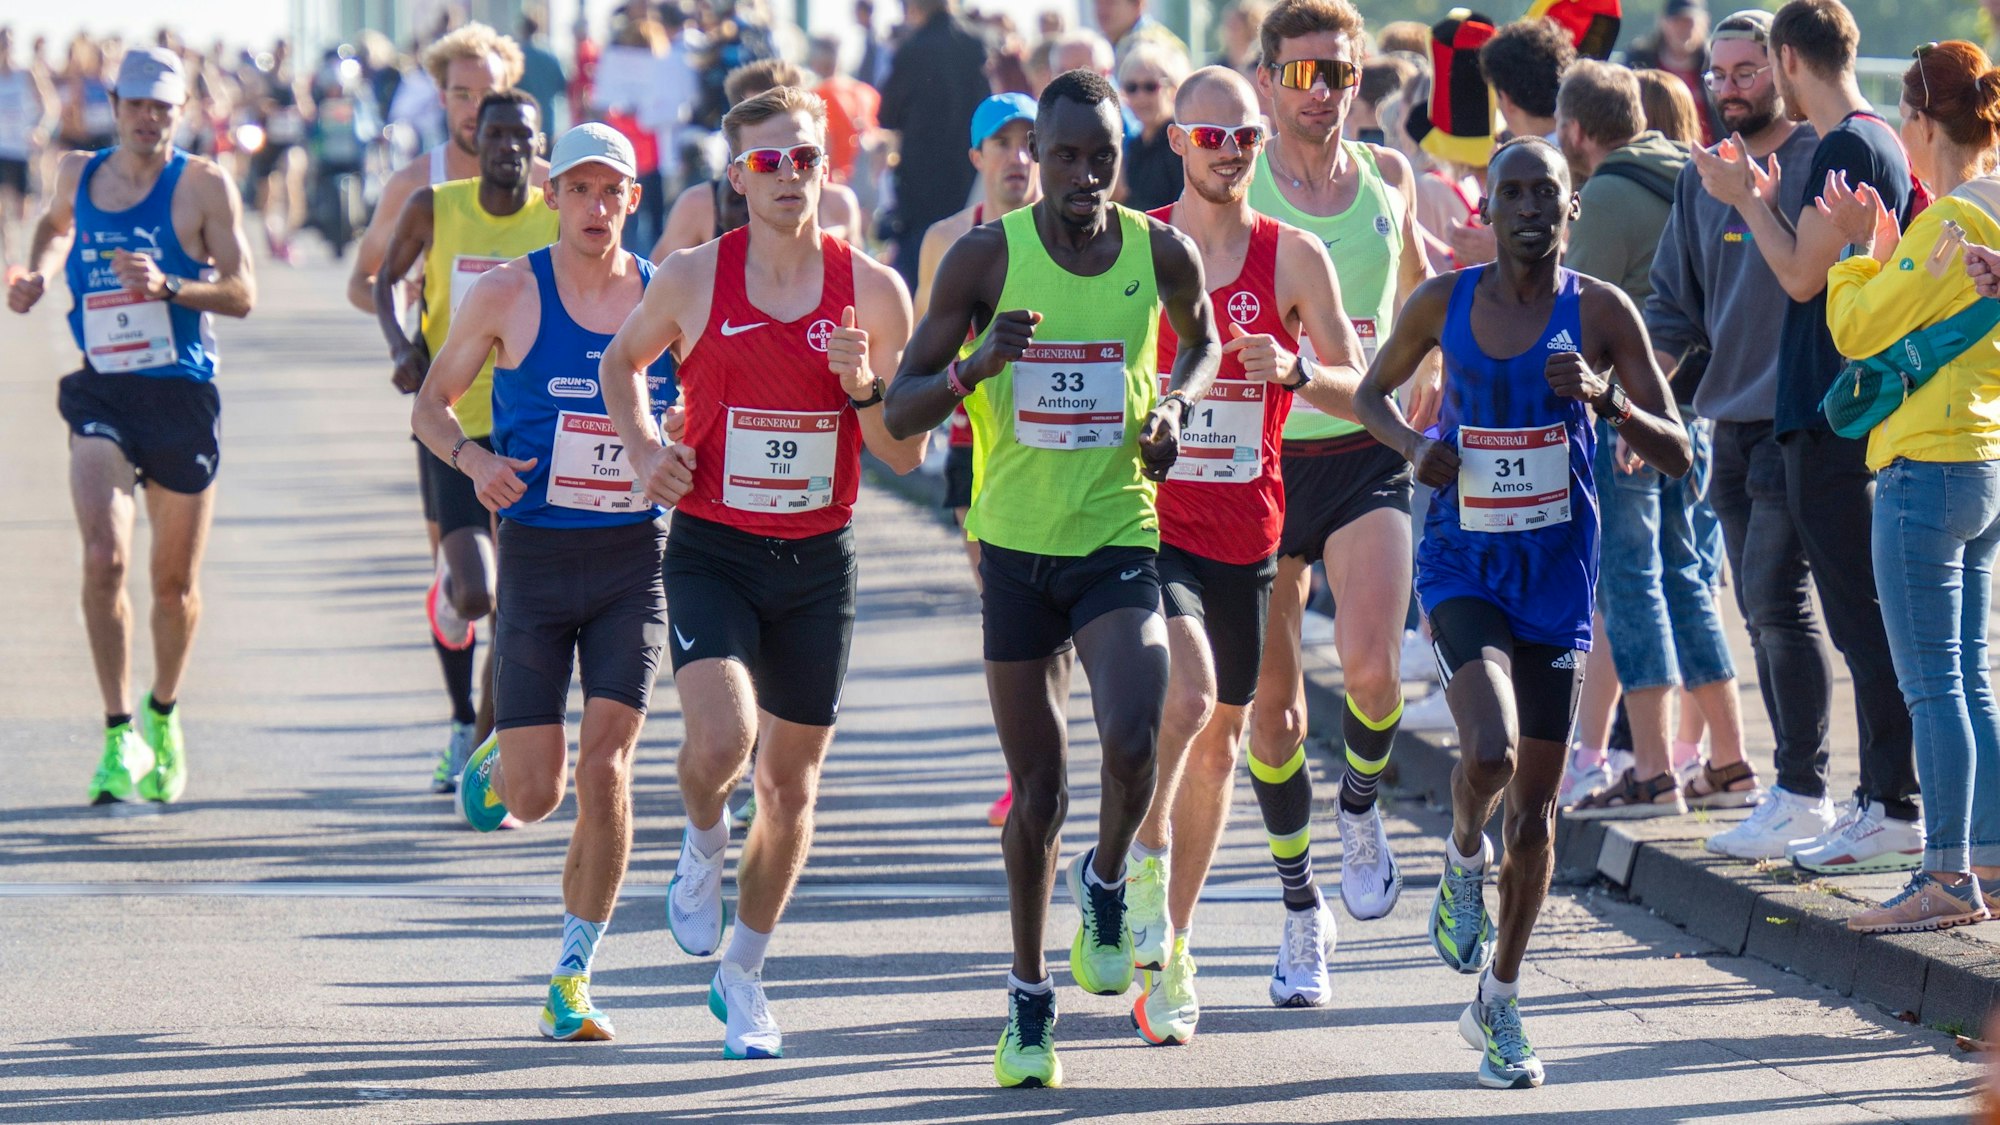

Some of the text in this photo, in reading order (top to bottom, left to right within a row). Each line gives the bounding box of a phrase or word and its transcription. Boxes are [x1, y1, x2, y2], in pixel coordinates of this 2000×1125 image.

[117, 313, 129, 328] 9
[1546, 342, 1577, 351] adidas
[1036, 349, 1086, 359] GENERALI
[1051, 372, 1084, 392] 33
[1037, 395, 1098, 410] Anthony
[753, 417, 800, 430] GENERALI
[1202, 408, 1213, 428] 1
[1077, 435, 1097, 443] PUMA
[1480, 435, 1528, 446] GENERALI
[593, 443, 624, 462] 17
[765, 440, 798, 459] 39
[591, 464, 620, 476] Tom
[770, 462, 791, 475] Till
[1495, 457, 1525, 477] 31
[1491, 481, 1534, 493] Amos
[1525, 515, 1545, 524] PUMA
